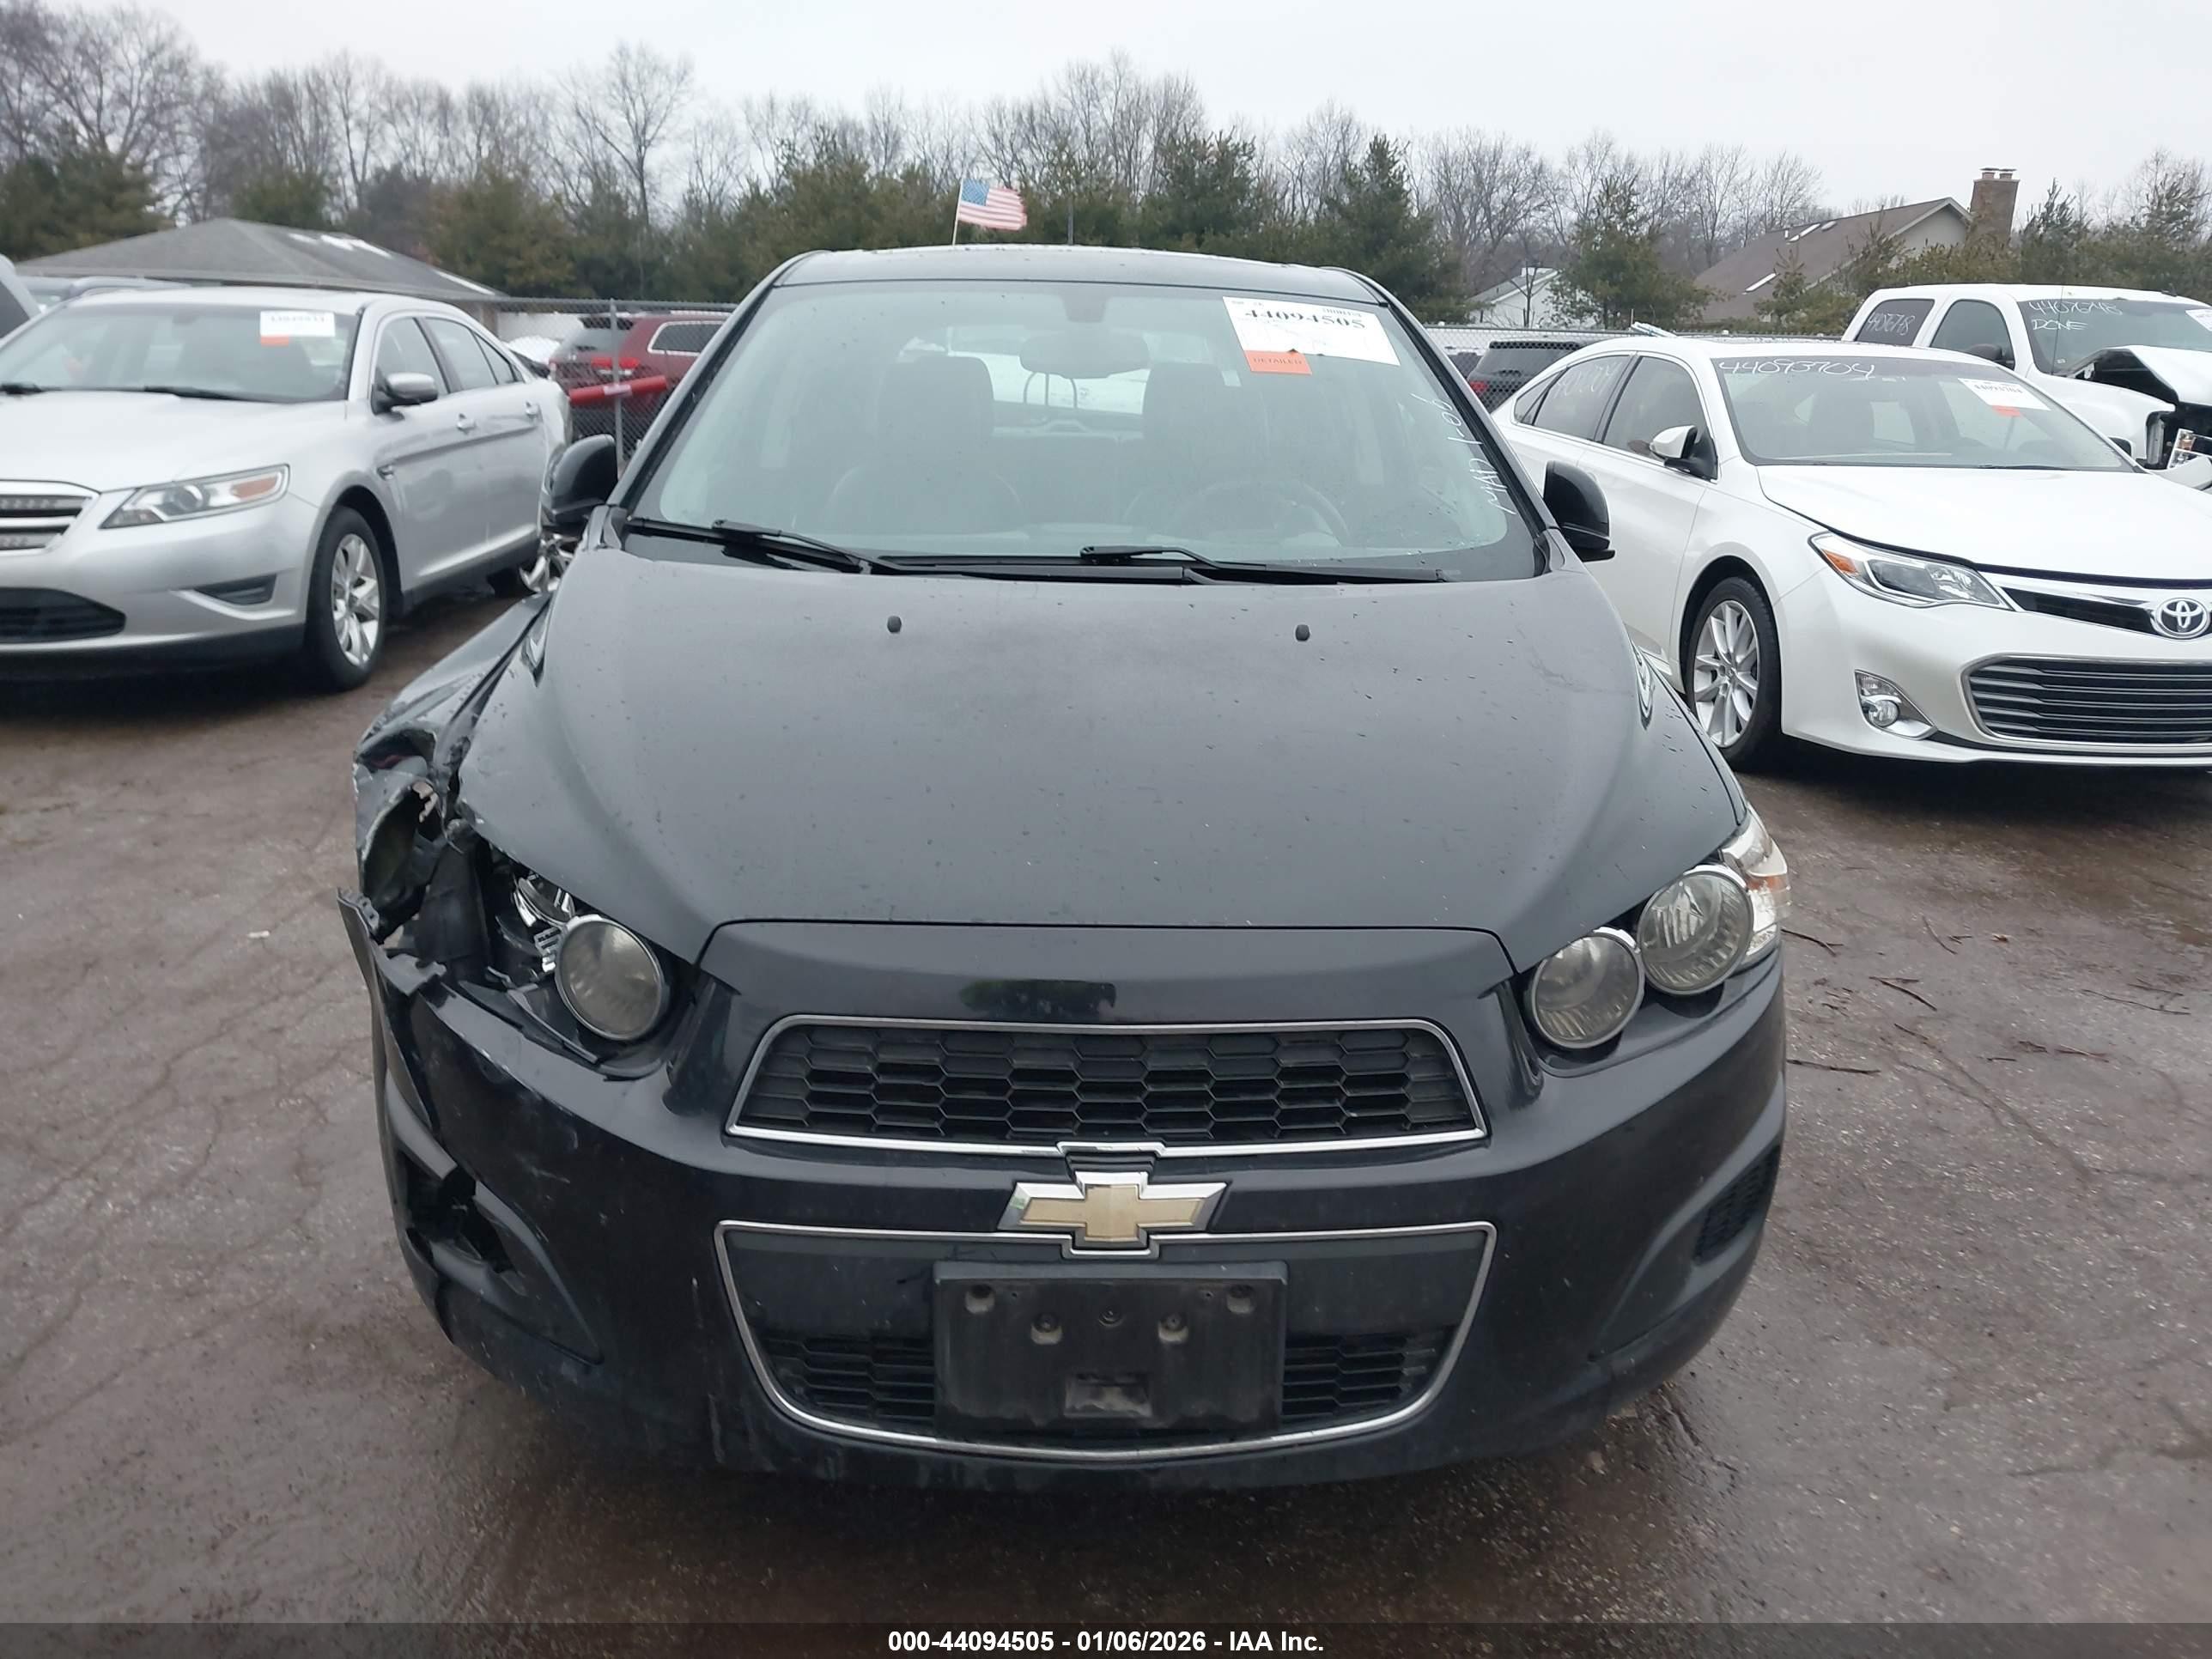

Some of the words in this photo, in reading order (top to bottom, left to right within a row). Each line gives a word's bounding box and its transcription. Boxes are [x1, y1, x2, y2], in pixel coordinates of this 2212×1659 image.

[1245, 308, 1366, 329] 44094505
[2032, 319, 2088, 331] DONE
[1718, 358, 1875, 380] 44093704
